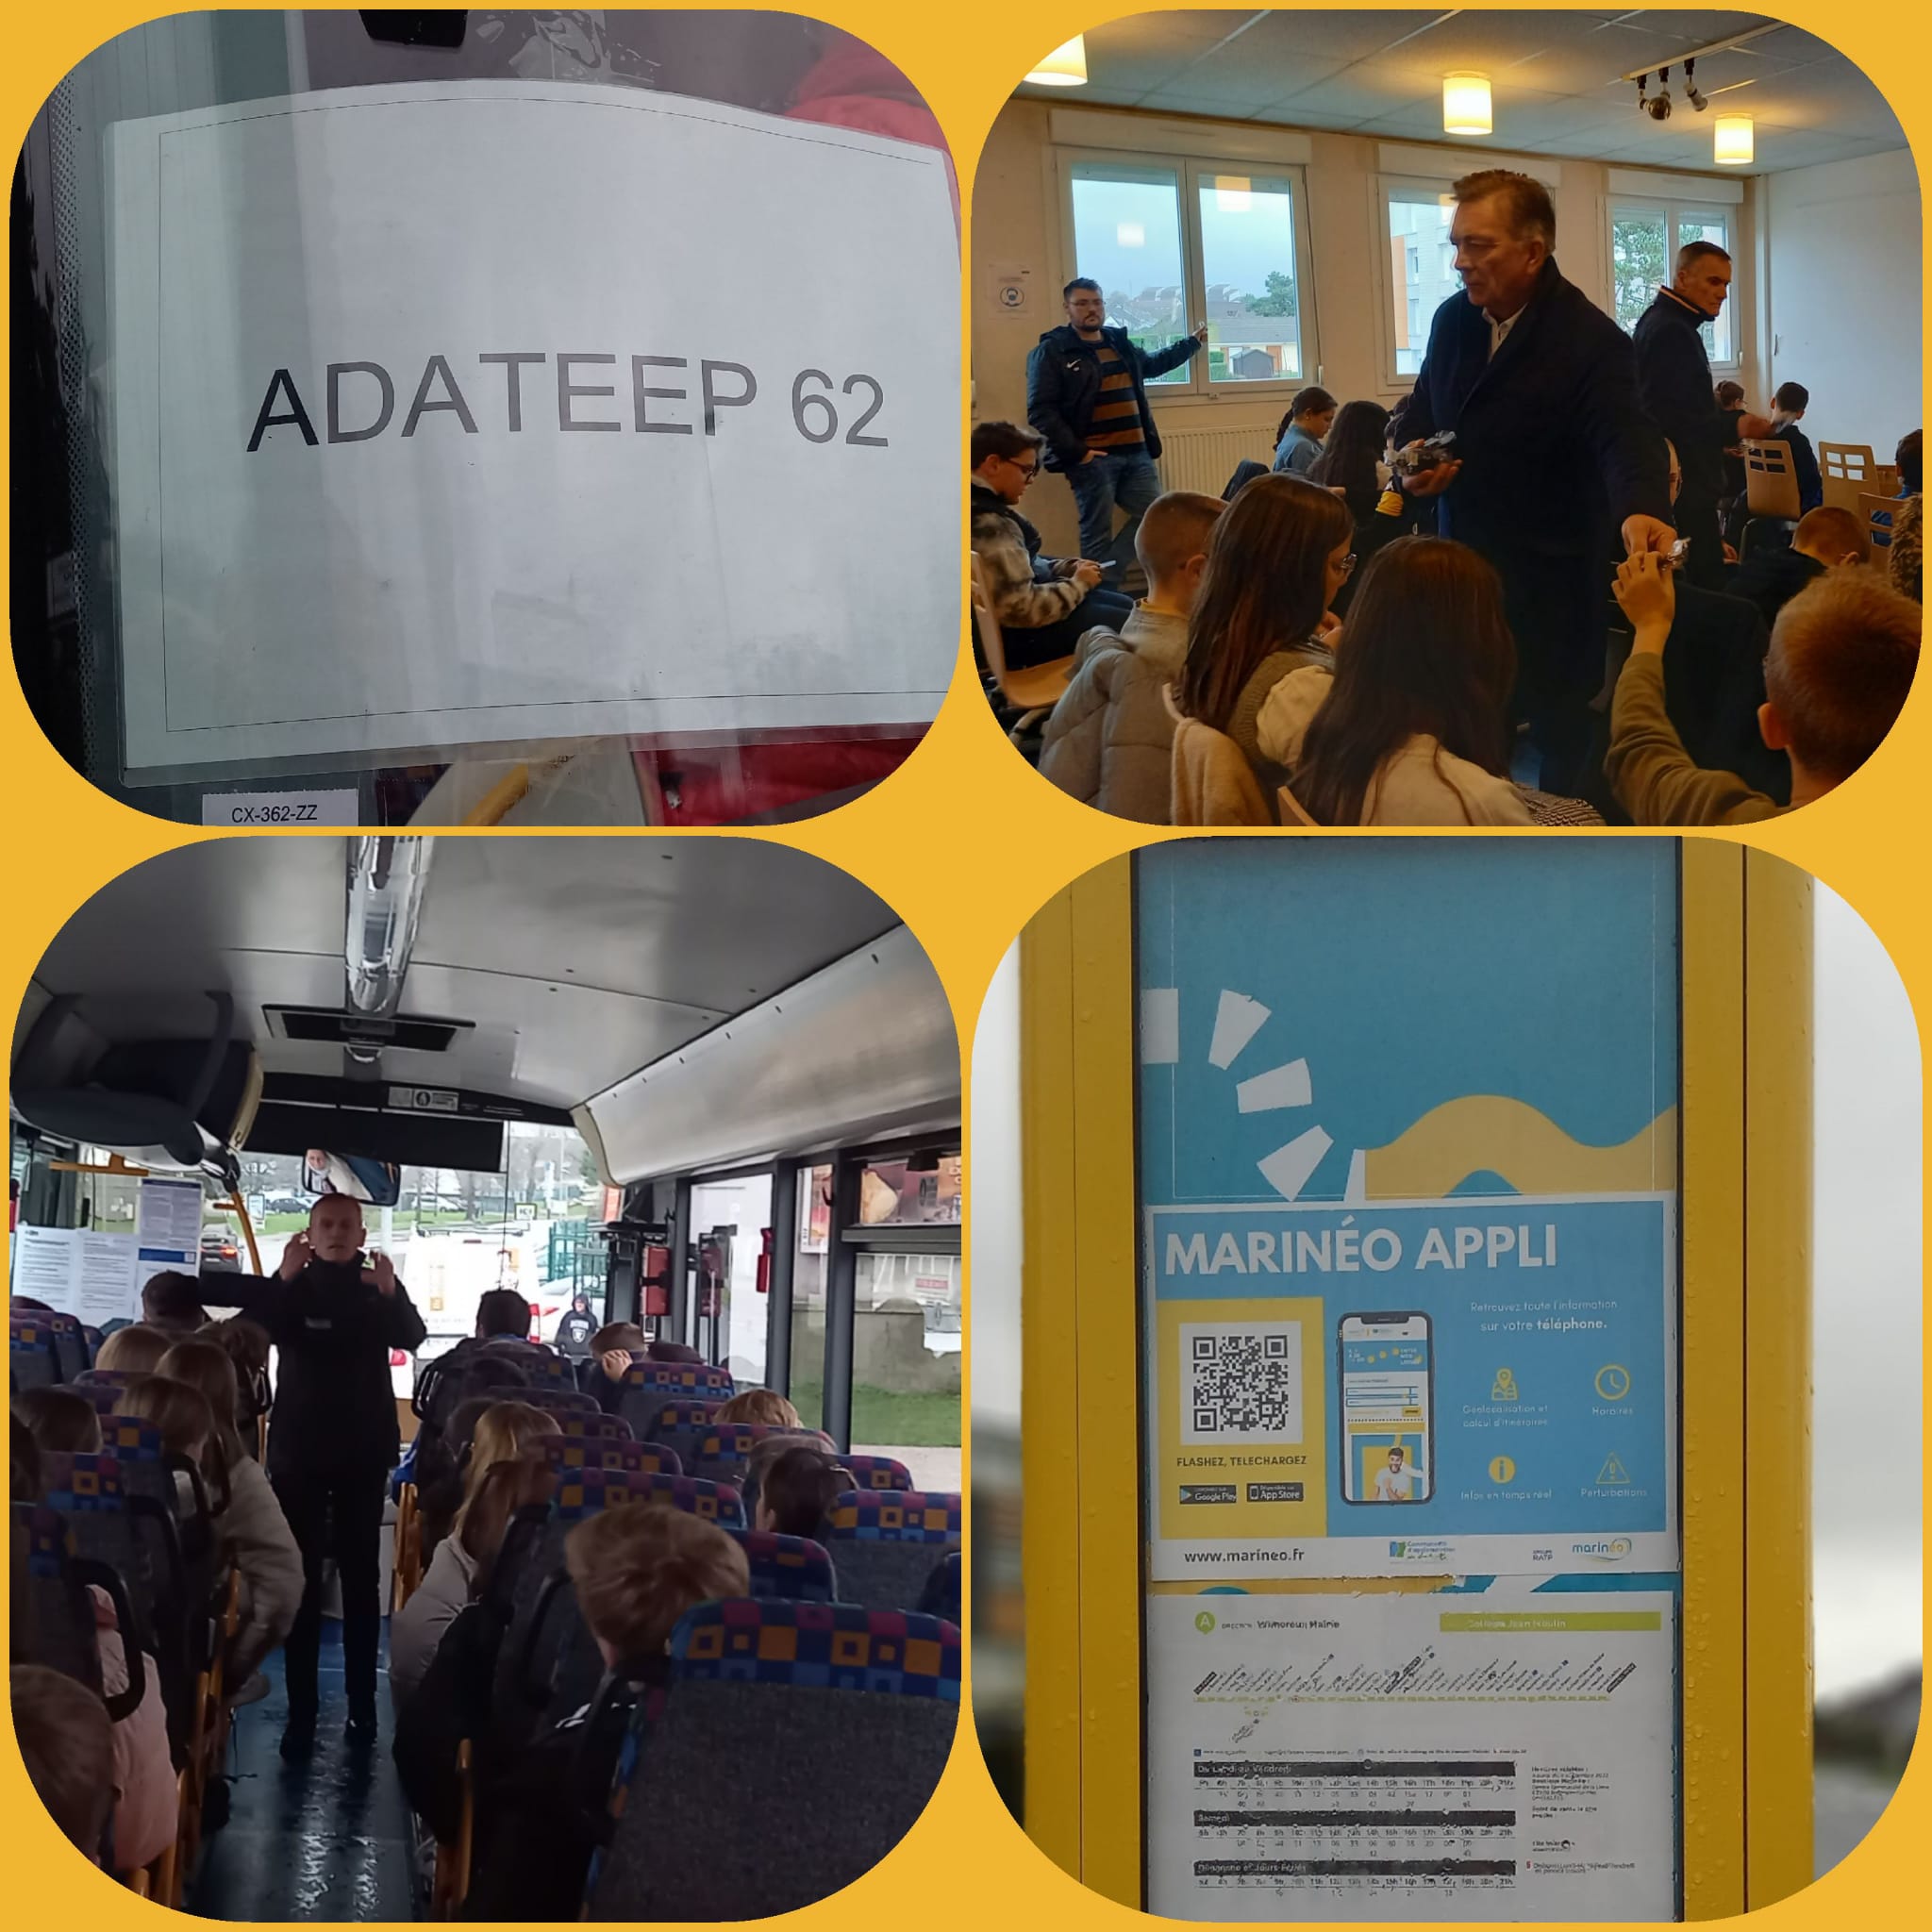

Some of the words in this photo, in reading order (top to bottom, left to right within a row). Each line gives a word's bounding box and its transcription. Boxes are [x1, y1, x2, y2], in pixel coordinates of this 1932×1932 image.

[246, 352, 758, 453] ADATEEP
[791, 368, 889, 448] 62
[231, 804, 318, 824] CX-362-ZZ
[1165, 1214, 1403, 1274] MARINÉO
[1415, 1224, 1557, 1270] APPLI
[1471, 1302, 1522, 1312] Retrouvez
[1524, 1301, 1551, 1311] toute
[1480, 1323, 1499, 1331] sur
[1503, 1320, 1534, 1331] votre
[1537, 1317, 1607, 1332] téléphone.
[1463, 1418, 1491, 1427] calcul
[1176, 1457, 1227, 1468] FLASHEZ,
[1230, 1456, 1307, 1466] TELECHARGEZ
[1194, 1492, 1221, 1503] Google
[1222, 1491, 1237, 1503] Play
[1259, 1491, 1277, 1501] App
[1278, 1491, 1300, 1499] Store
[1184, 1548, 1305, 1562] www.marineo.fr
[1199, 1614, 1211, 1628] A
